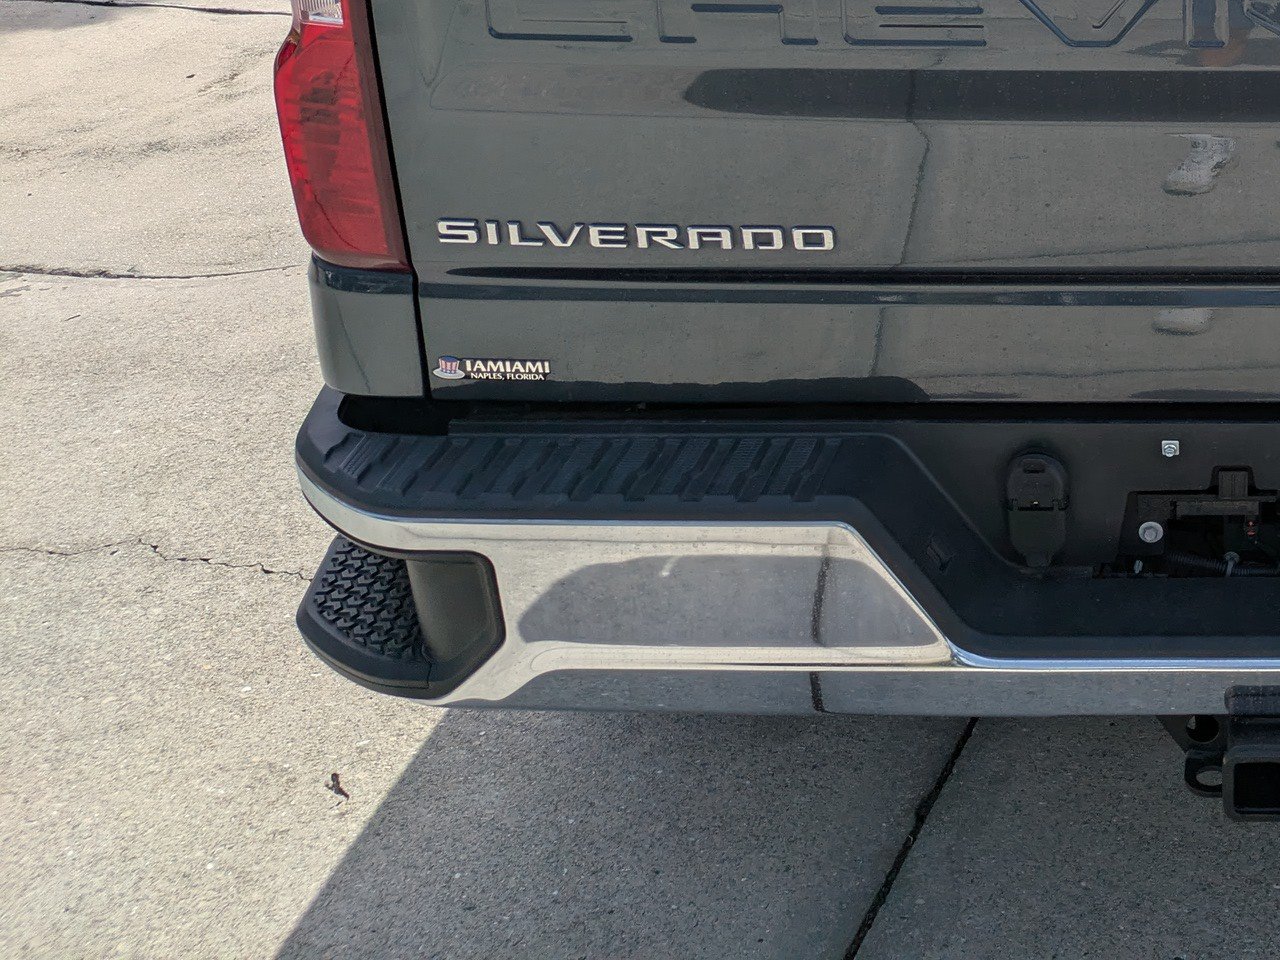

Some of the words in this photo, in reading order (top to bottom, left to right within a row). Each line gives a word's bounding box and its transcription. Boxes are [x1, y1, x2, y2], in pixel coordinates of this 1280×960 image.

[436, 217, 835, 251] SILVERADO
[470, 372, 506, 381] NAPLES,
[506, 373, 545, 381] FLORIDA
